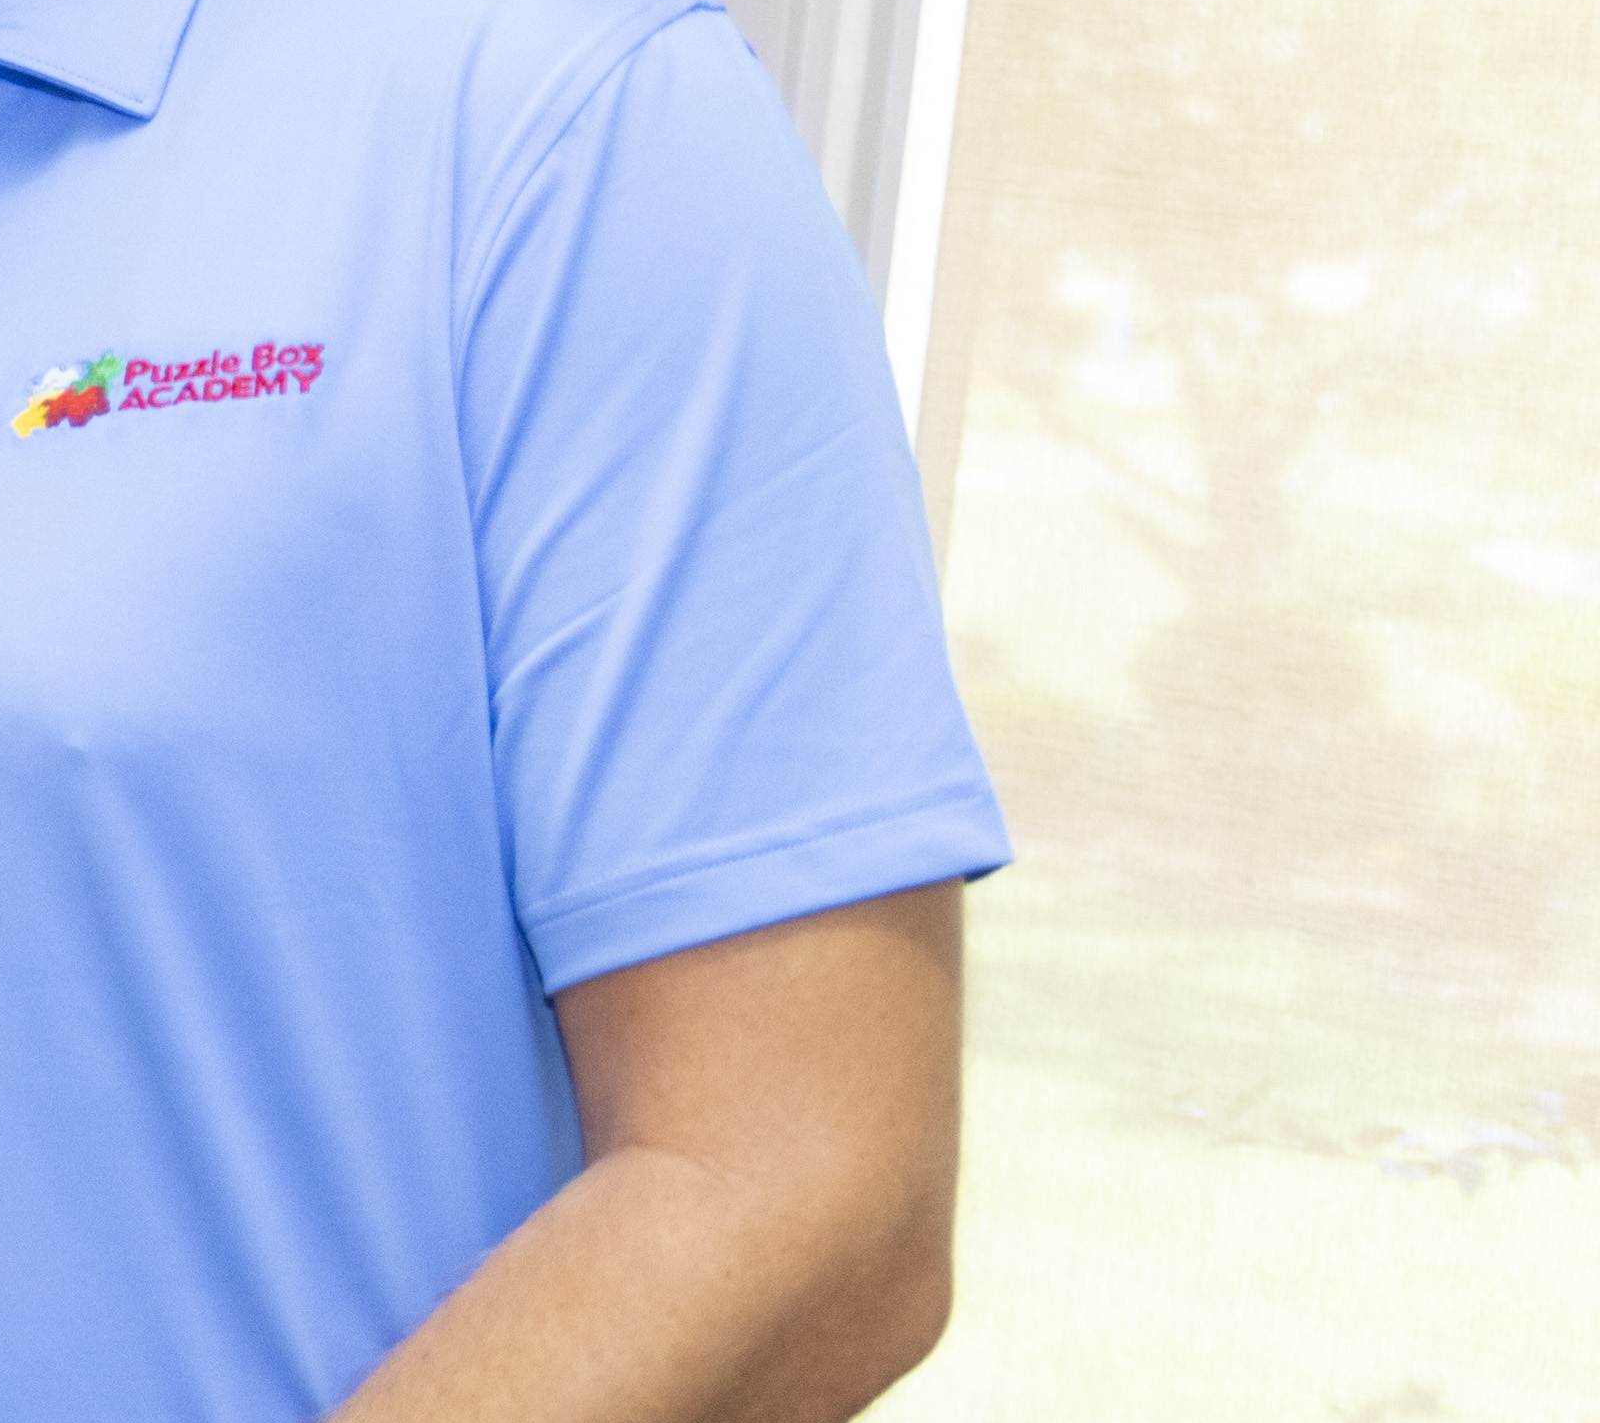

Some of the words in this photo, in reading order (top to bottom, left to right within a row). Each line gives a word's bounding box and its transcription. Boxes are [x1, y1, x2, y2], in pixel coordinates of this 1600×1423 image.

[124, 349, 242, 386] Puzzle
[252, 342, 325, 373] Box
[119, 367, 322, 411] ACADEMY
